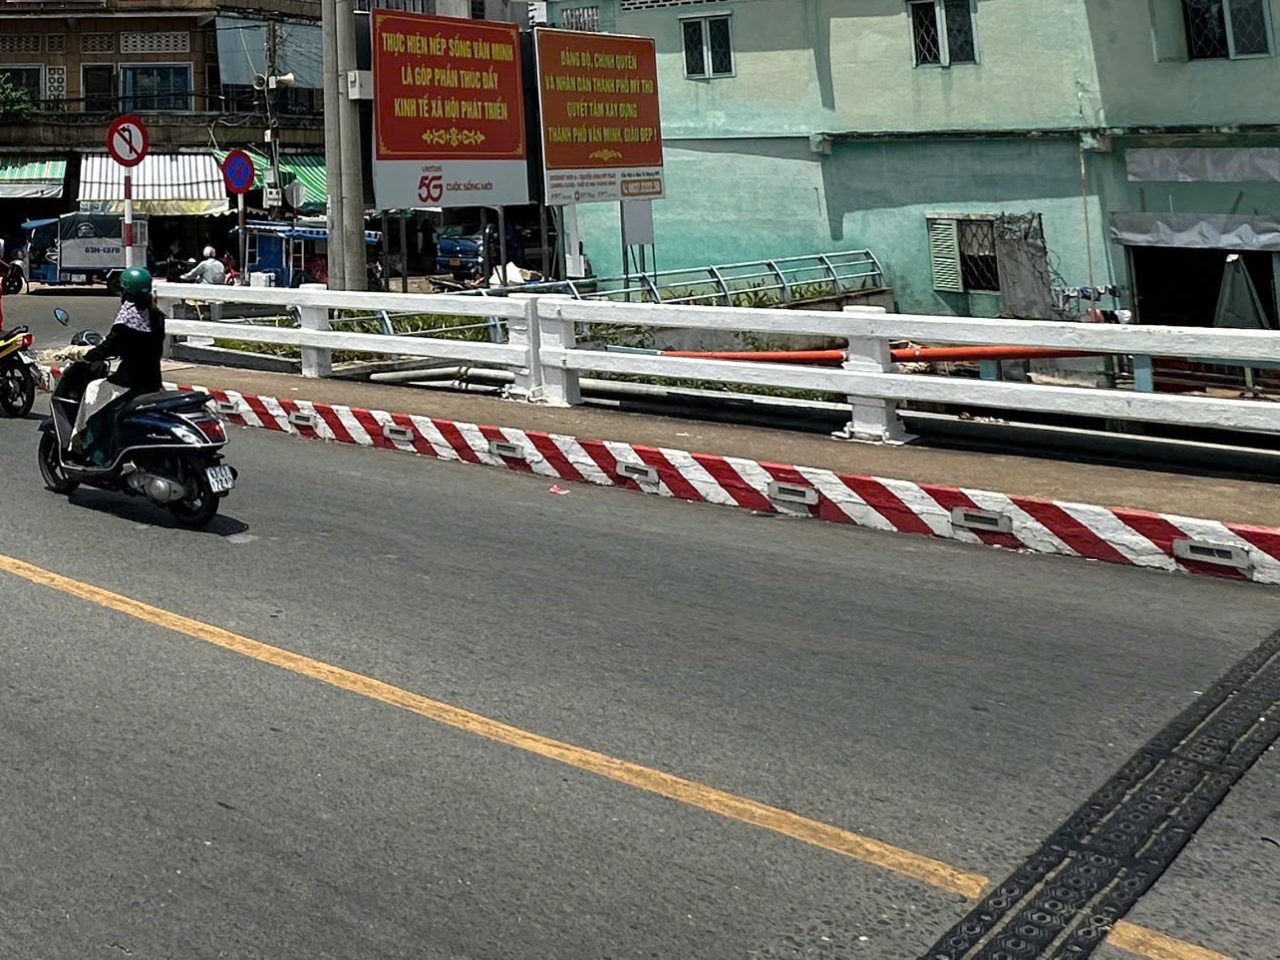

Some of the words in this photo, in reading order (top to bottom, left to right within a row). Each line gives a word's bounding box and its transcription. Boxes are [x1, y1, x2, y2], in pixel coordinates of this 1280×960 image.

[449, 34, 472, 58] SỐNG
[401, 62, 413, 85] LÀ
[415, 63, 432, 86] GÓP
[394, 98, 417, 117] KINH
[418, 93, 429, 118] TẾ
[417, 175, 443, 202] 5G
